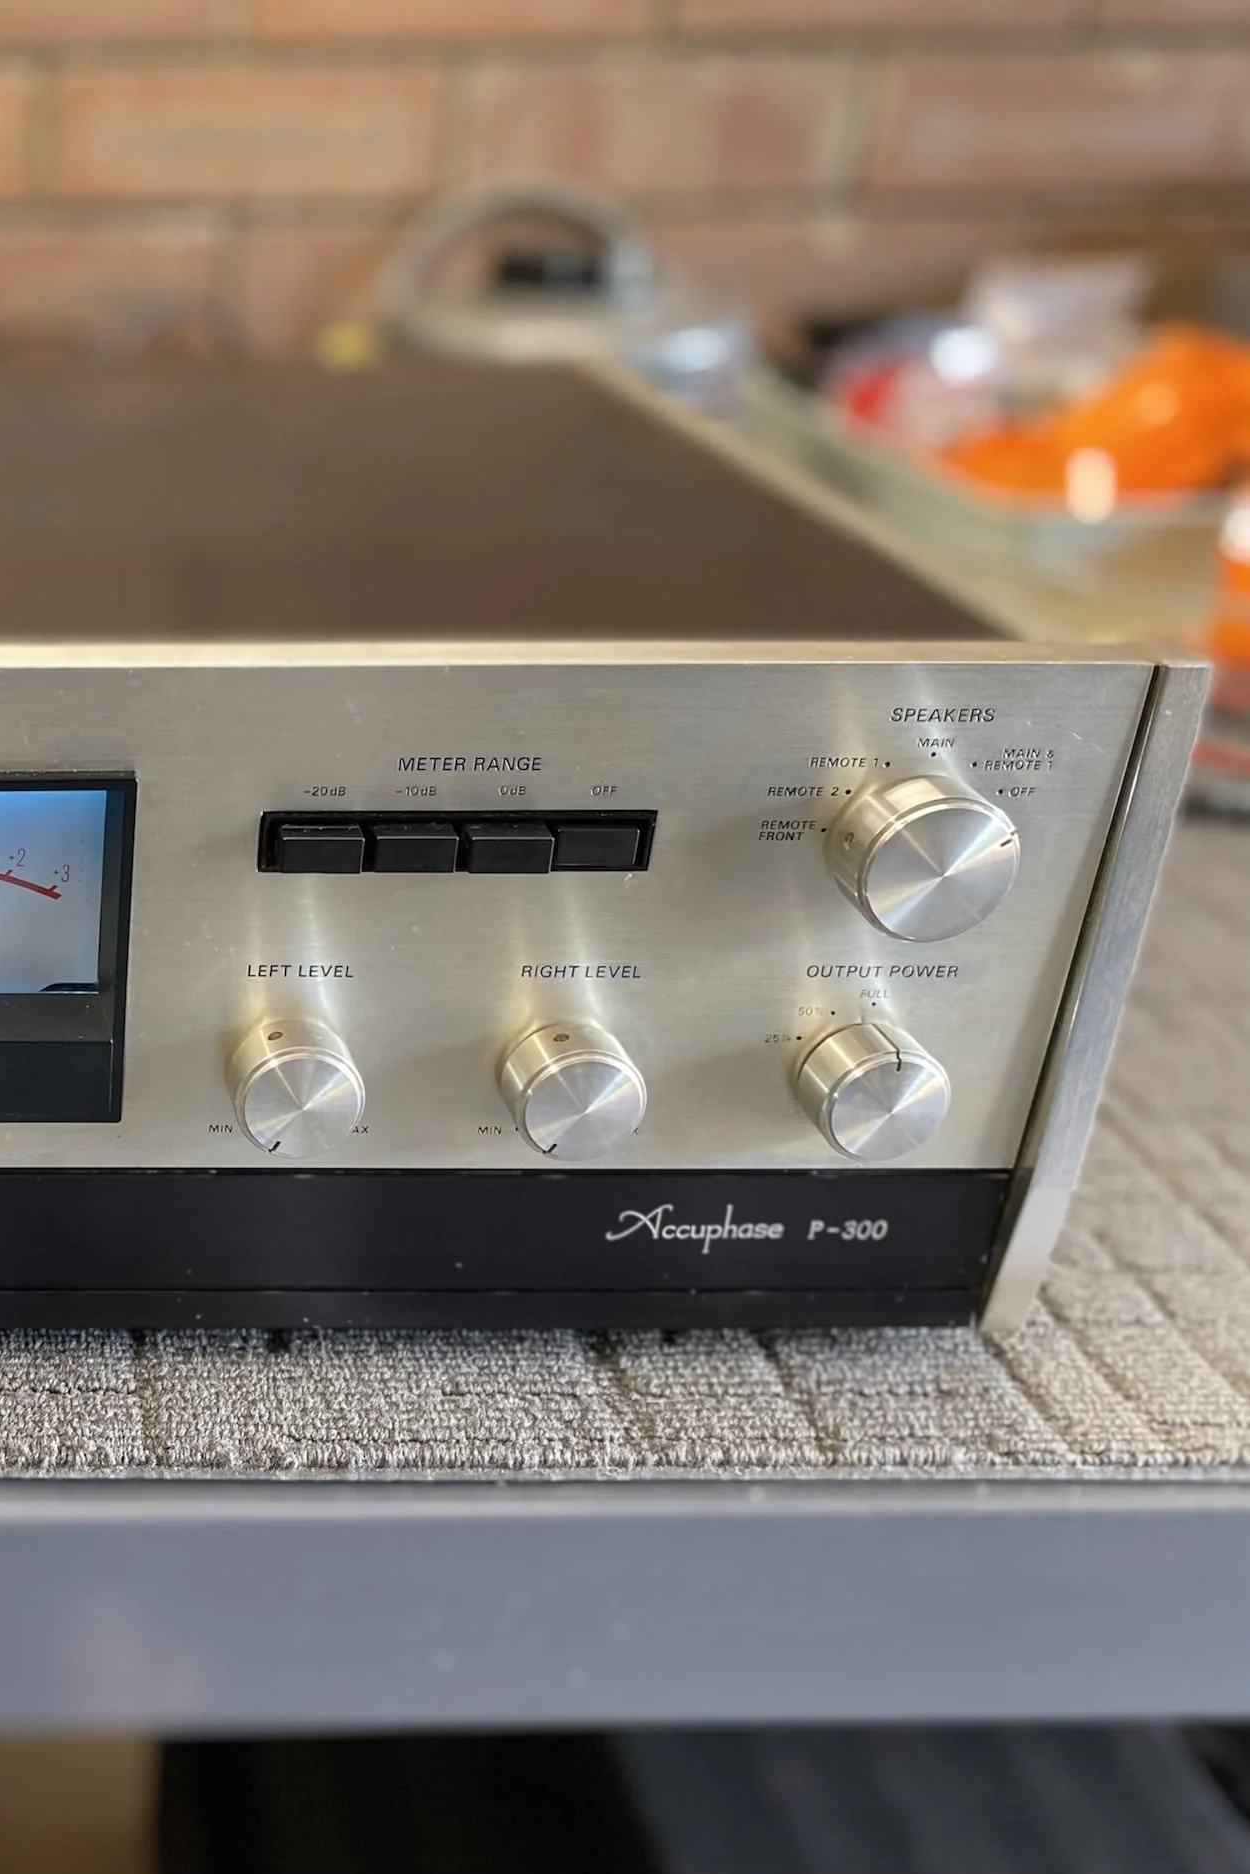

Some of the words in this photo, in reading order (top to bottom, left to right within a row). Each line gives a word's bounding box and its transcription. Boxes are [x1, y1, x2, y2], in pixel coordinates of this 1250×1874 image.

[889, 707, 996, 723] SPEAKERS
[916, 738, 955, 749] MAIN
[1002, 748, 1041, 759] MAIN
[397, 756, 467, 772] METER
[473, 756, 543, 772] RANGE
[810, 757, 867, 769] REMOTE
[870, 757, 879, 768] 1
[983, 760, 1042, 771] REMOTE
[590, 785, 618, 797] OFF
[767, 786, 824, 798] REMOTE
[830, 786, 840, 798] 2
[1008, 786, 1035, 797] OFF
[760, 820, 817, 831] REMOTE
[758, 831, 804, 842] FRONT
[246, 964, 292, 979] LEFT
[297, 964, 354, 979] LEVEL
[520, 965, 580, 979] RIGHT
[584, 965, 642, 979] LEVEL
[806, 964, 884, 978] OUTPUT
[888, 964, 959, 979] POWER
[859, 988, 890, 999] FULL
[208, 1124, 234, 1134] MIN
[477, 1126, 503, 1135] MIN
[605, 1203, 785, 1255] Accuphase
[807, 1219, 889, 1241] P-300
